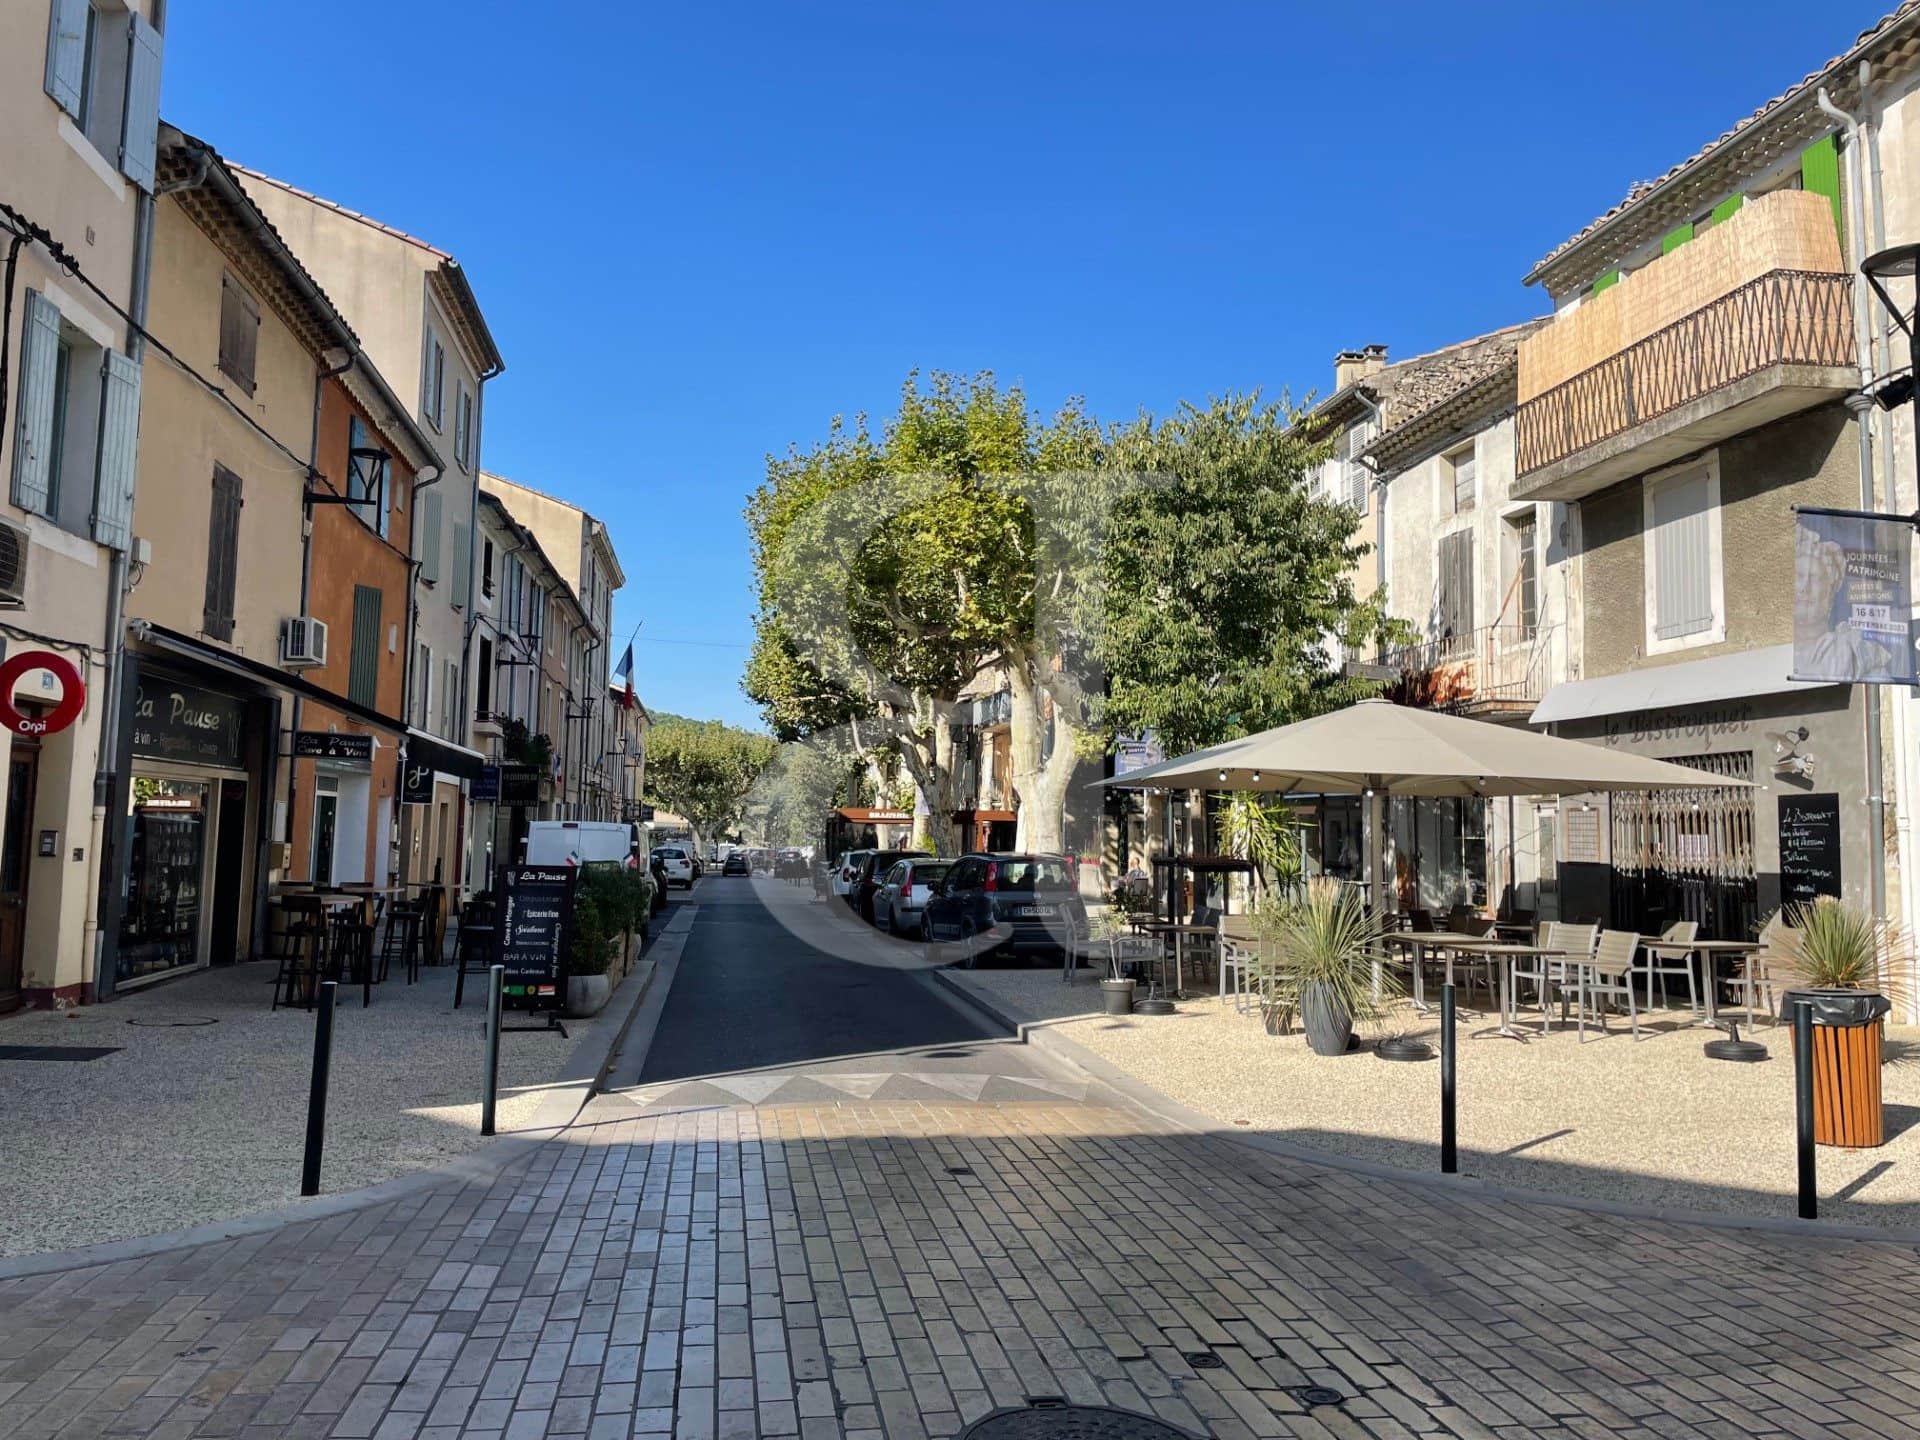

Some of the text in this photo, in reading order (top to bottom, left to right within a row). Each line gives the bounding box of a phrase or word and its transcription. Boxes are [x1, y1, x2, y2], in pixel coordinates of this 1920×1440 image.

[1848, 565, 1901, 581] PATRIMOINE
[1857, 608, 1887, 618] 16 & 17
[170, 693, 220, 730] Pause
[19, 720, 47, 734] Orpi
[1630, 703, 1752, 751] Bistroquet
[520, 871, 567, 881] La Pause
